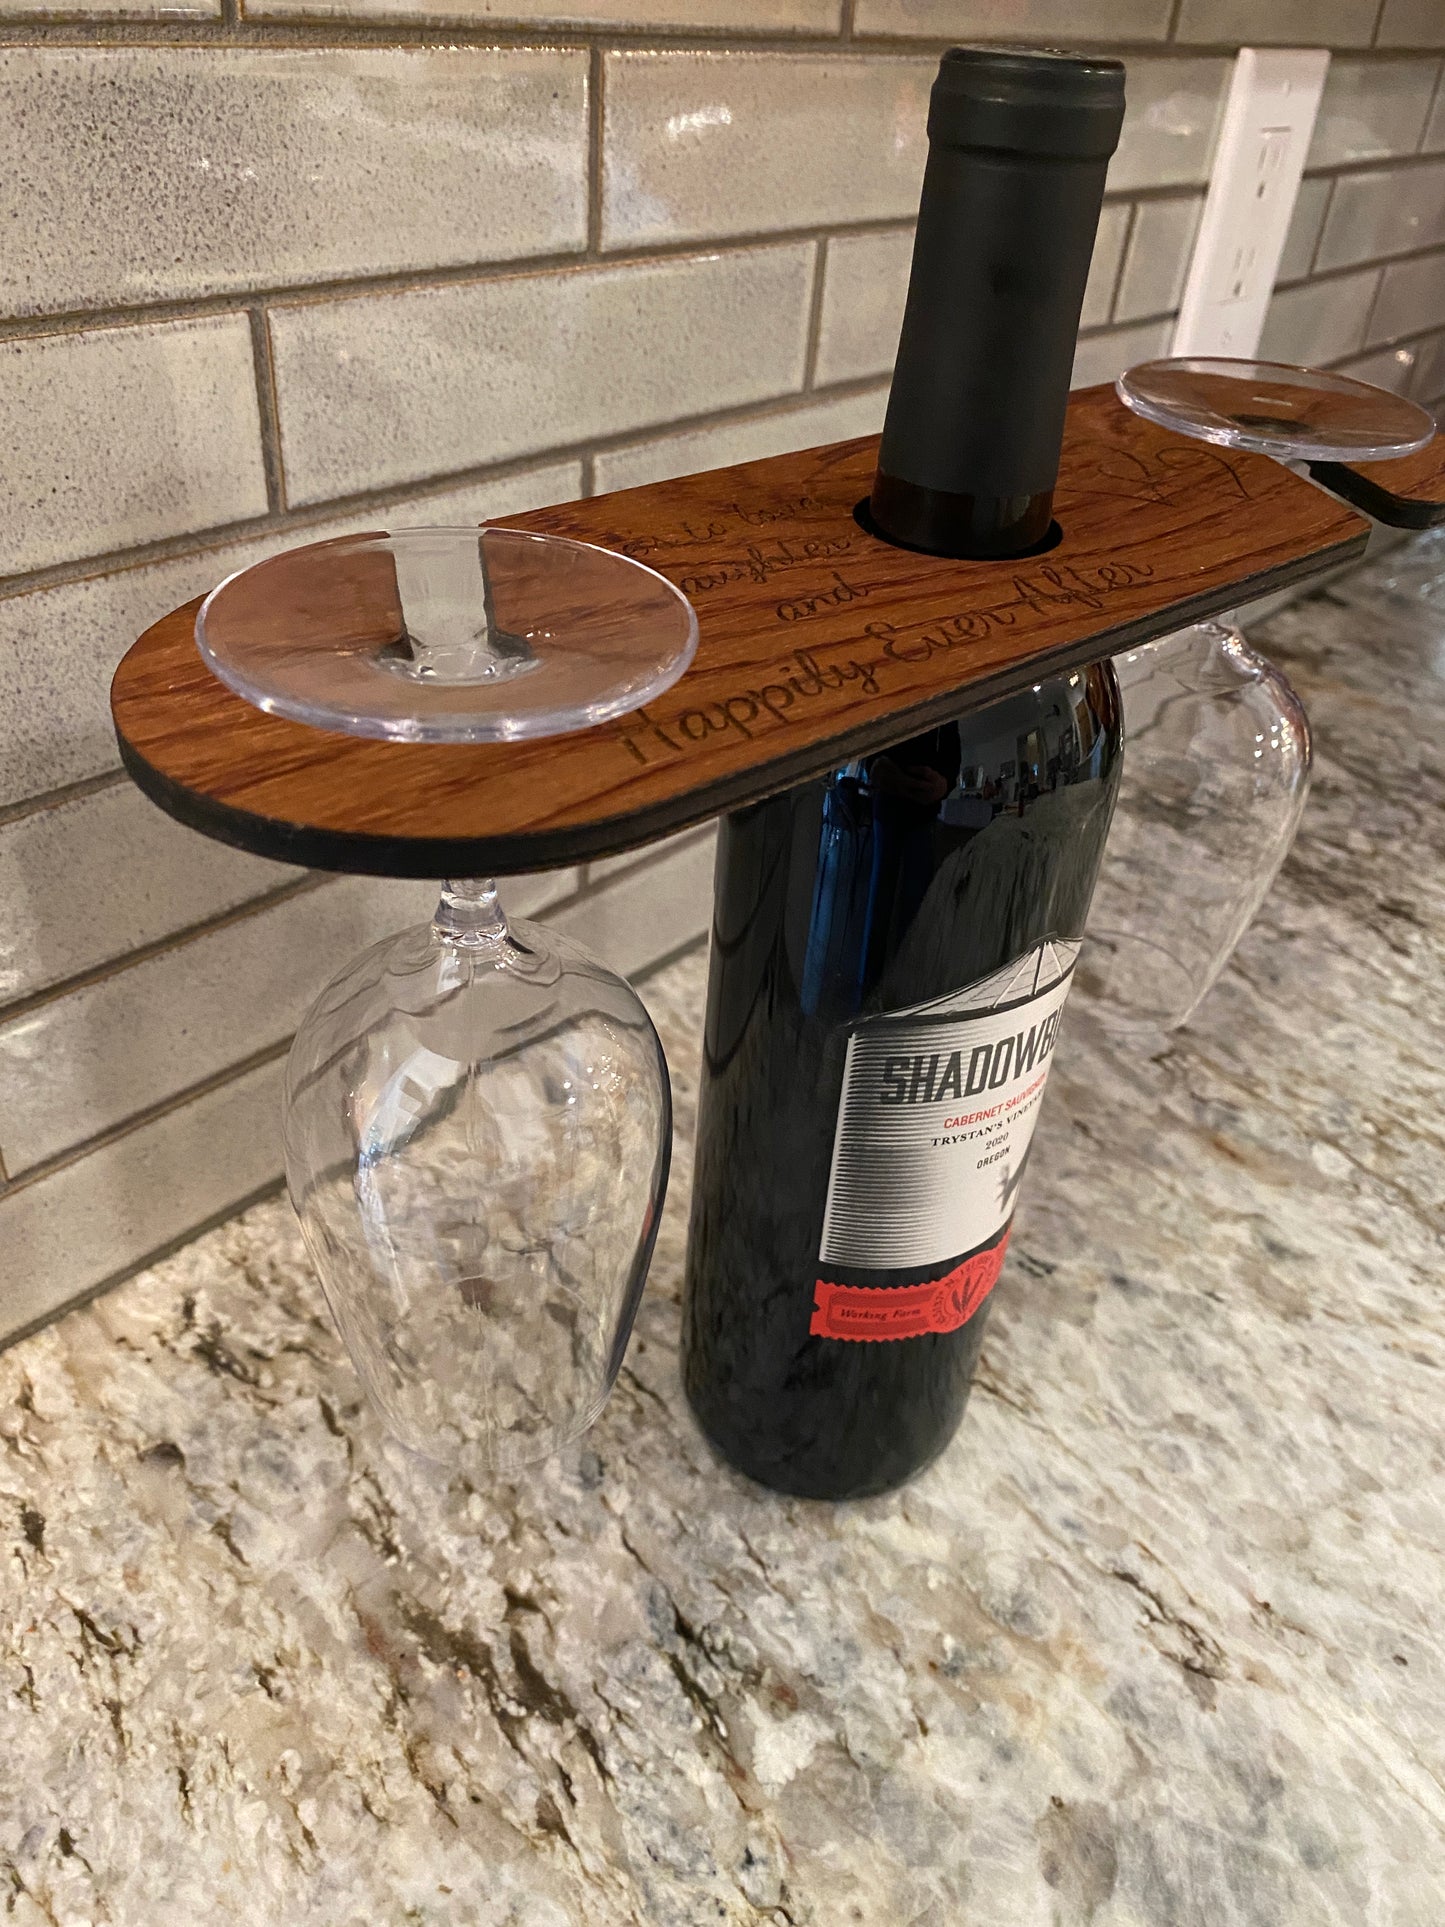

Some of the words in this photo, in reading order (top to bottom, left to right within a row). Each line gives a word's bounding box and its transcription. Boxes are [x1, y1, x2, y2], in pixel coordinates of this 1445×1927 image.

[680, 540, 851, 593] aughter
[776, 571, 869, 621] and
[621, 648, 881, 765] Happily
[863, 612, 1016, 663] Ever
[1012, 560, 1154, 617] After
[943, 1103, 1005, 1129] CABERNET
[930, 1120, 1003, 1148] TRYSTAN'S
[984, 1131, 1010, 1151] 2020
[976, 1145, 1011, 1170] OREGON
[840, 1307, 888, 1322] Working
[892, 1307, 921, 1319] Farm
